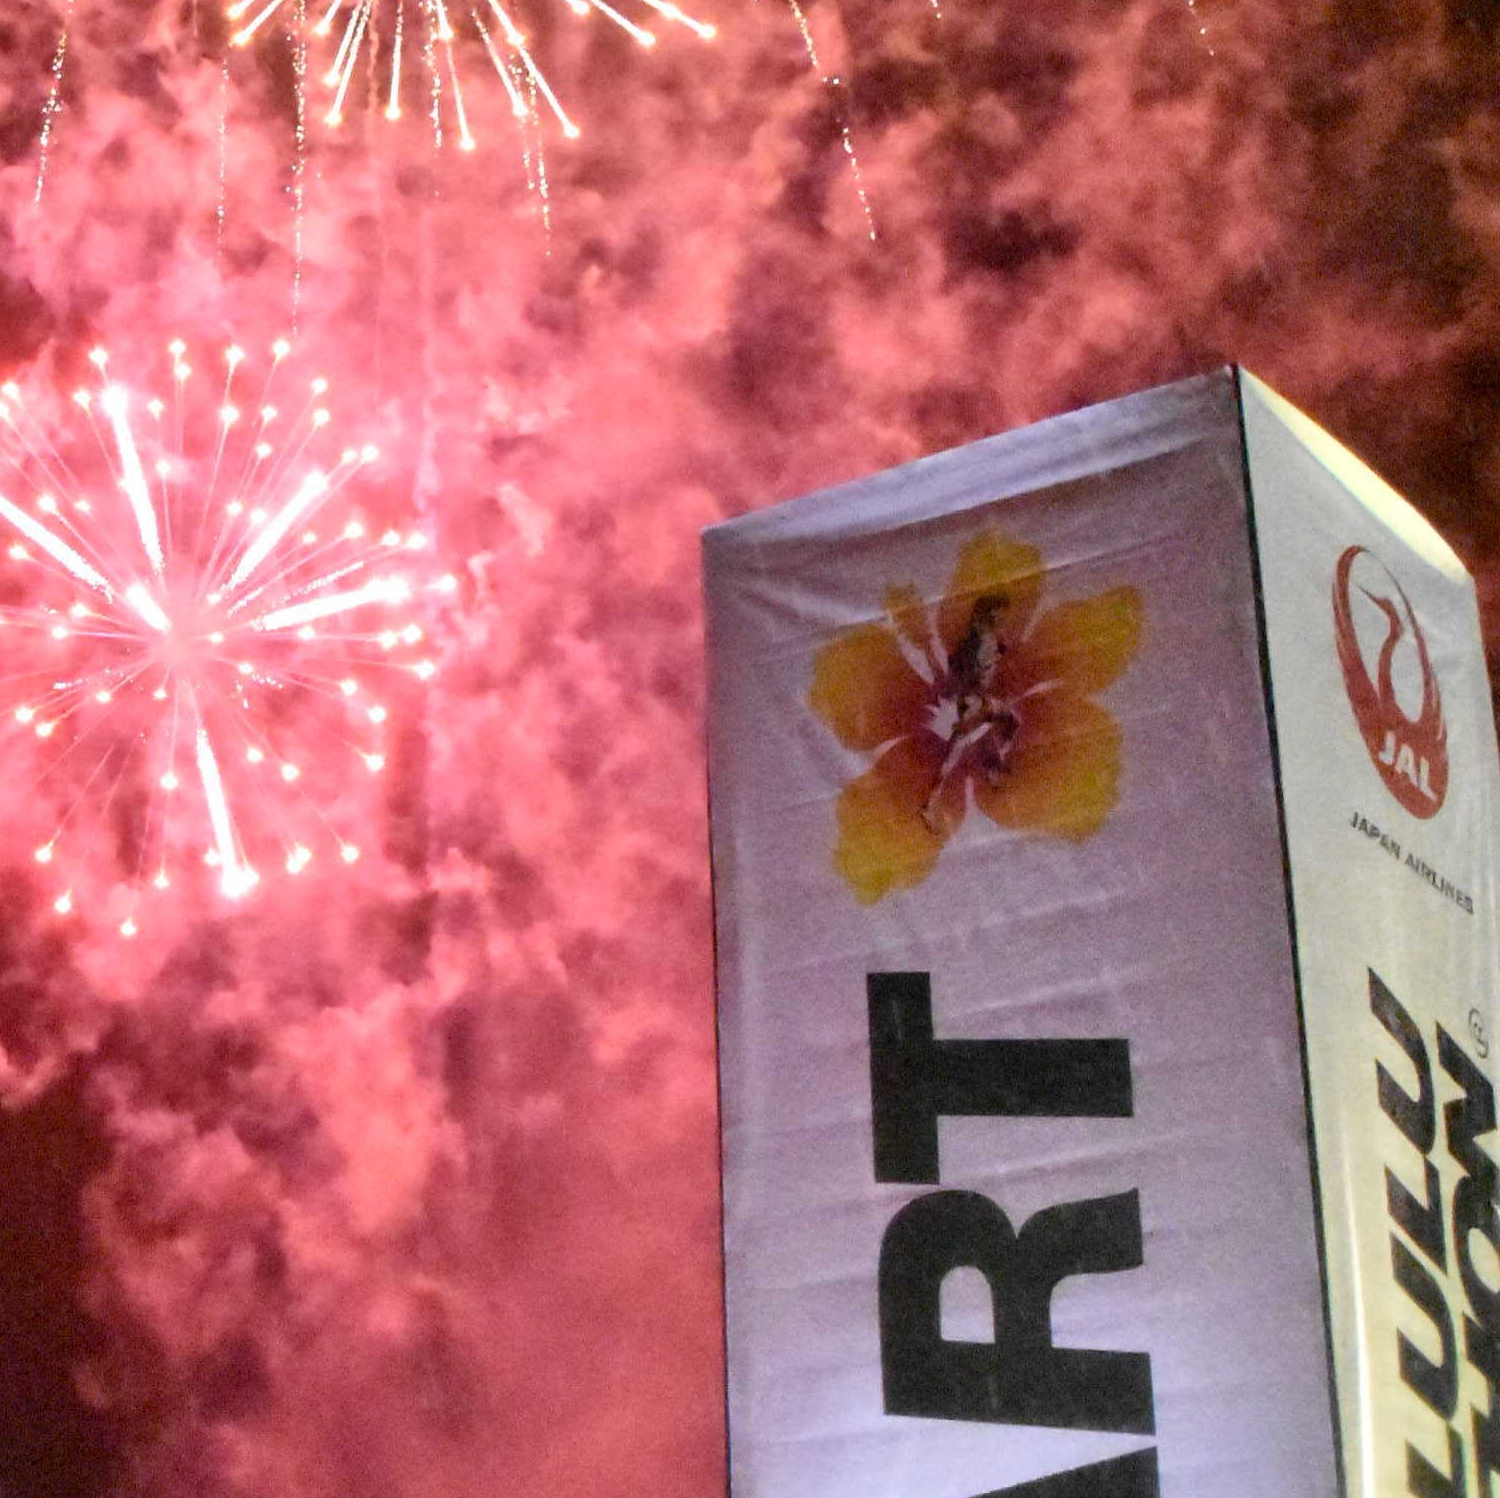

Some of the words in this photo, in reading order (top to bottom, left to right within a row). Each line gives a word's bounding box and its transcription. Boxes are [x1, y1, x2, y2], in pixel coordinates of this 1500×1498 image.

[1379, 729, 1437, 803] JAL
[1350, 811, 1401, 862] JAPAN
[1404, 851, 1474, 916] AIRLINES
